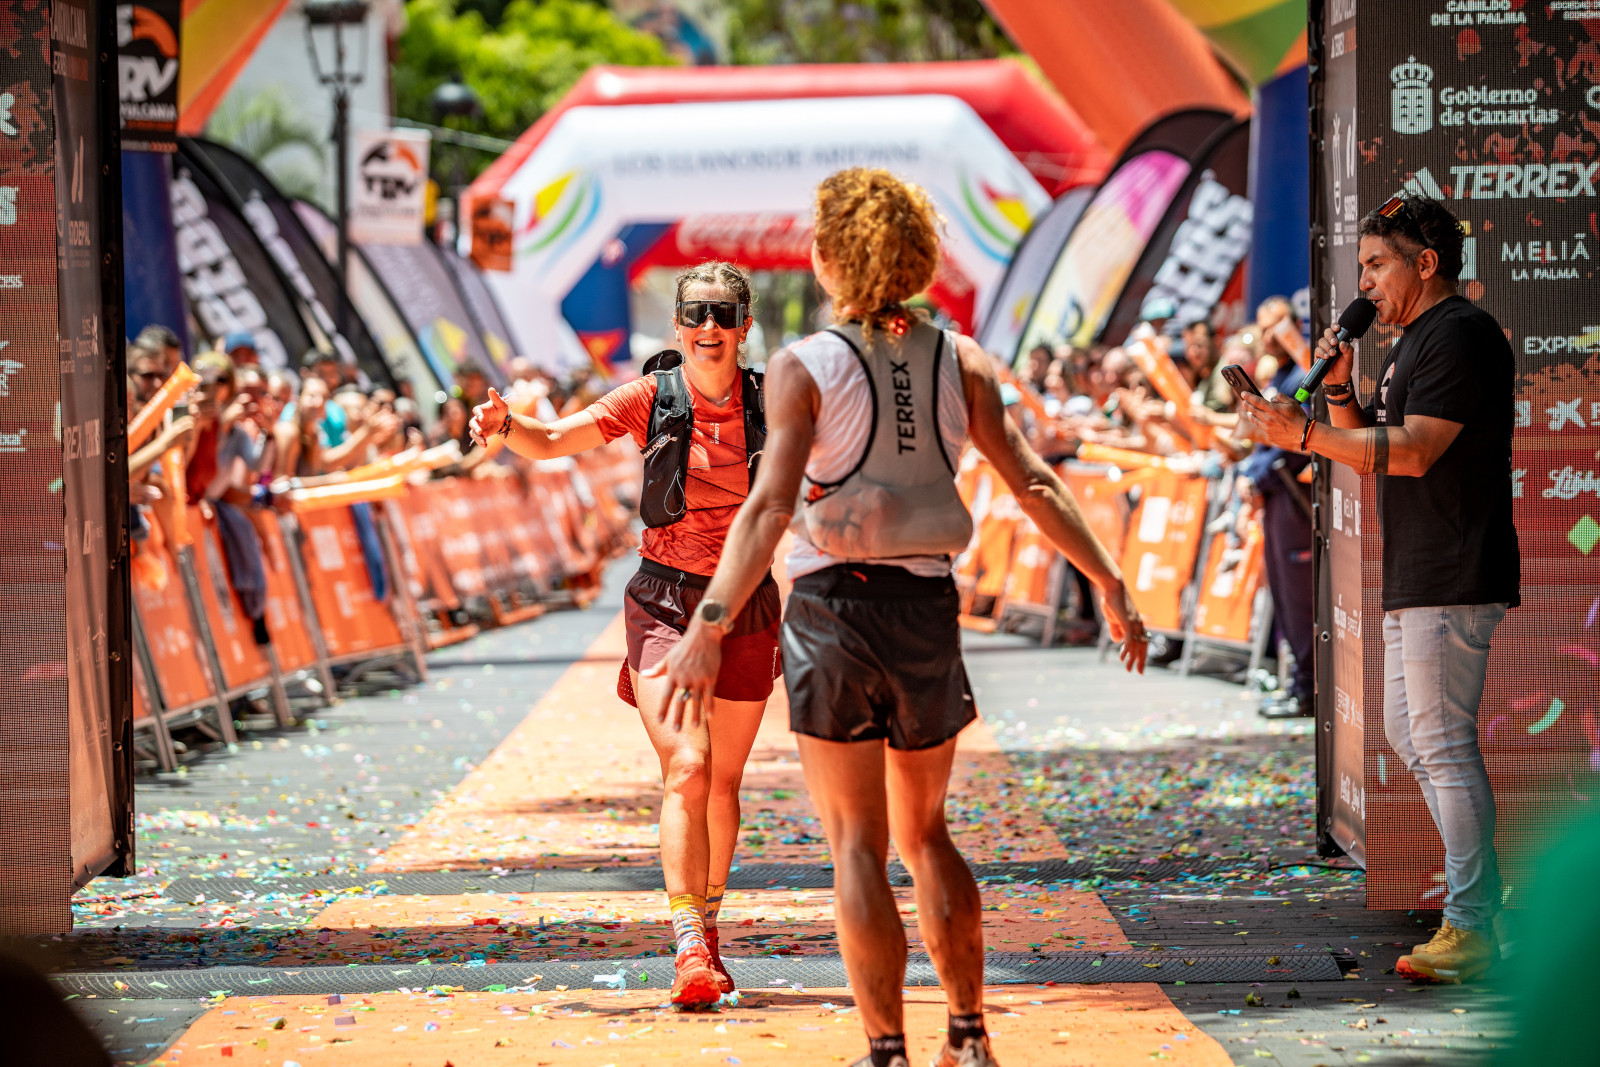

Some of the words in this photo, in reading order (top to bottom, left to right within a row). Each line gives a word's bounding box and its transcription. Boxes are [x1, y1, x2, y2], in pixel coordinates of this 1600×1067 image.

[1431, 13, 1450, 26] DE
[1453, 13, 1474, 26] LA
[1477, 11, 1526, 25] PALMA
[1440, 85, 1537, 105] Gobierno
[1440, 107, 1465, 126] de
[1467, 104, 1559, 125] Canarias
[1450, 163, 1600, 201] TERREX
[1511, 268, 1530, 282] LA
[1533, 267, 1580, 281] PALMA
[889, 360, 916, 456] TERREX
